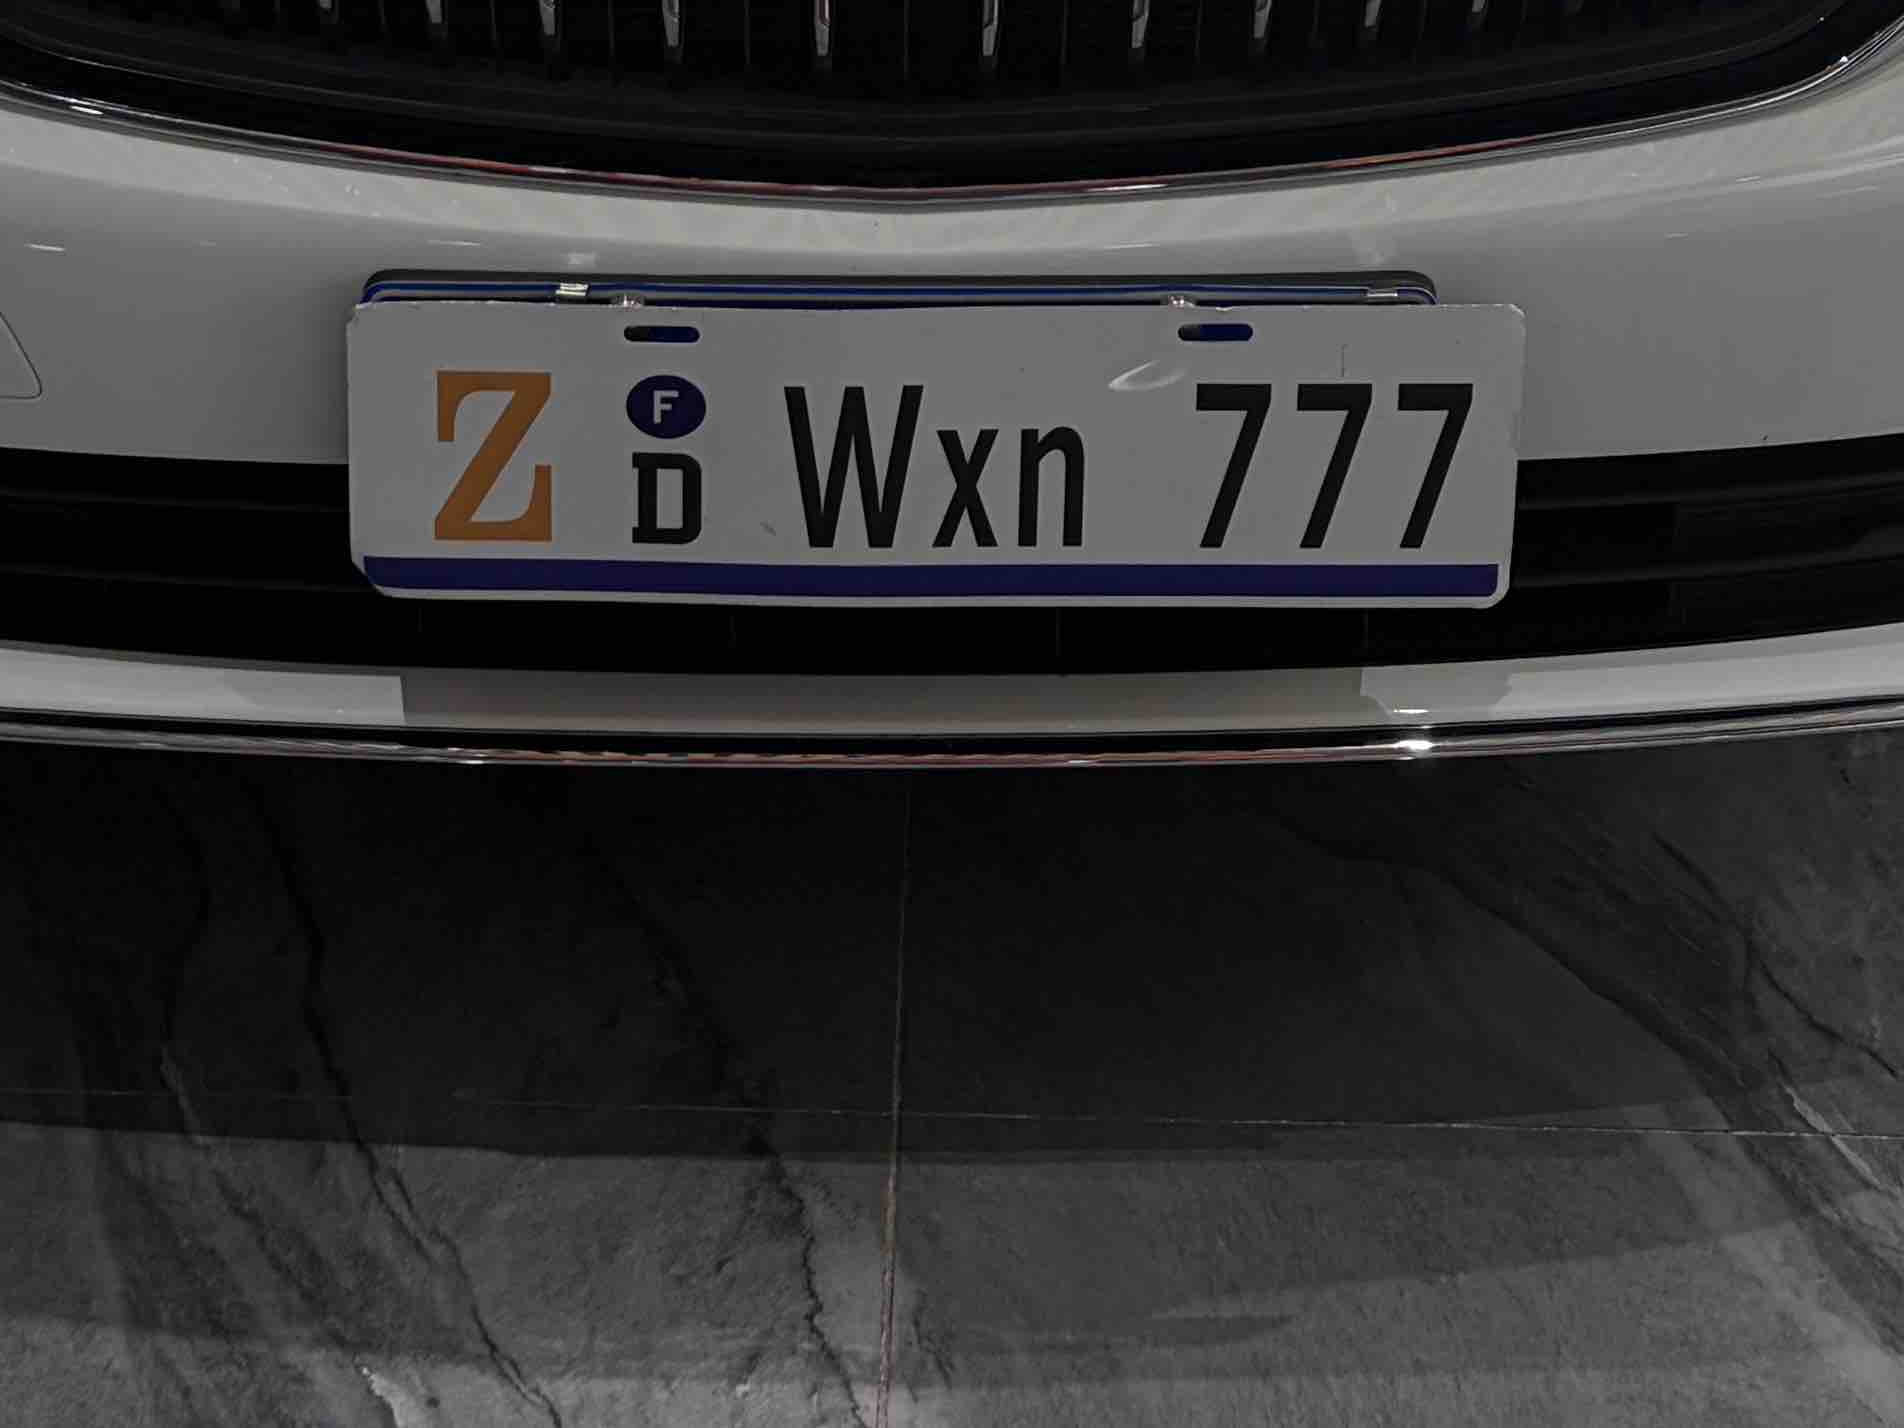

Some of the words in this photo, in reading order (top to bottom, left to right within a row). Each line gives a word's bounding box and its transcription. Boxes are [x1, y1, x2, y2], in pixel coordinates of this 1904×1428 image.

[434, 371, 552, 542] Z
[631, 451, 703, 546] D
[783, 384, 1085, 549] Wxn
[1195, 383, 1474, 550] 777
[653, 389, 680, 425] F
